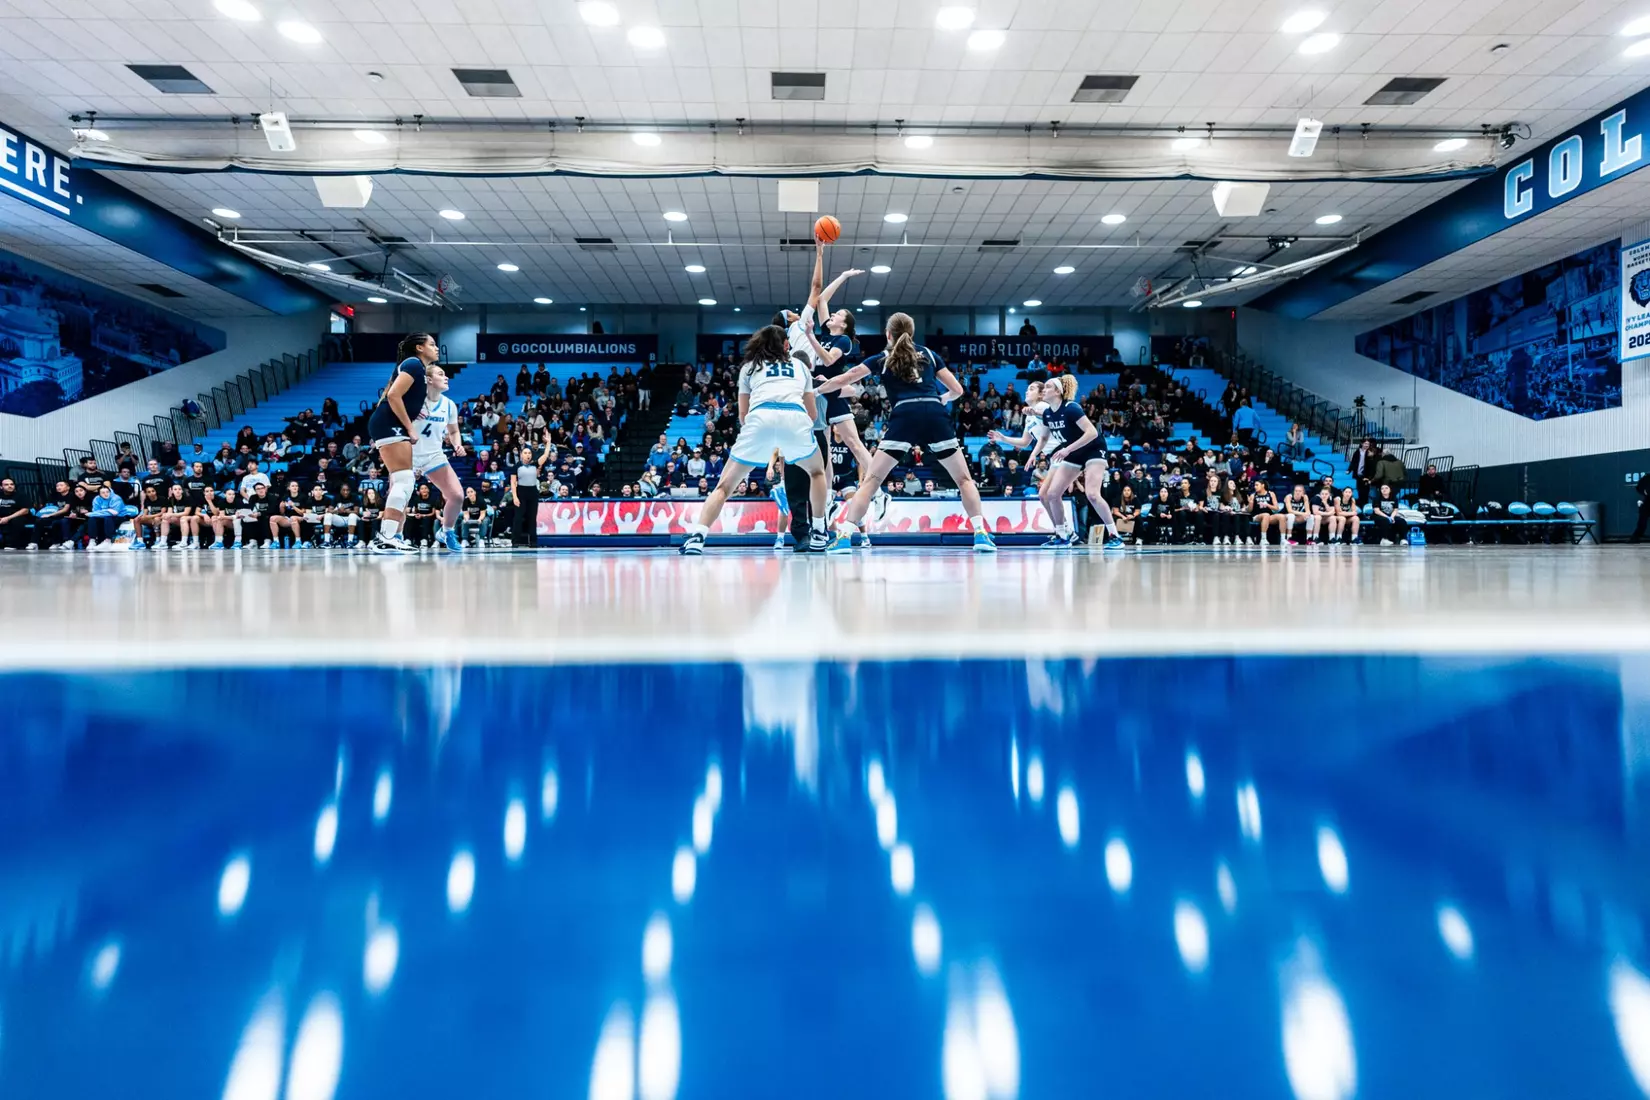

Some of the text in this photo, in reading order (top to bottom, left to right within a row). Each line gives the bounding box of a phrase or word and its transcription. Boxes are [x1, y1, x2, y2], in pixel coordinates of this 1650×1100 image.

[1504, 108, 1642, 219] COL
[1629, 332, 1650, 349] 202
[959, 343, 1080, 357] #RORLIOROAR
[766, 361, 795, 378] 35
[392, 427, 402, 436] Y
[421, 422, 432, 438] 4
[1099, 449, 1106, 459] Y
